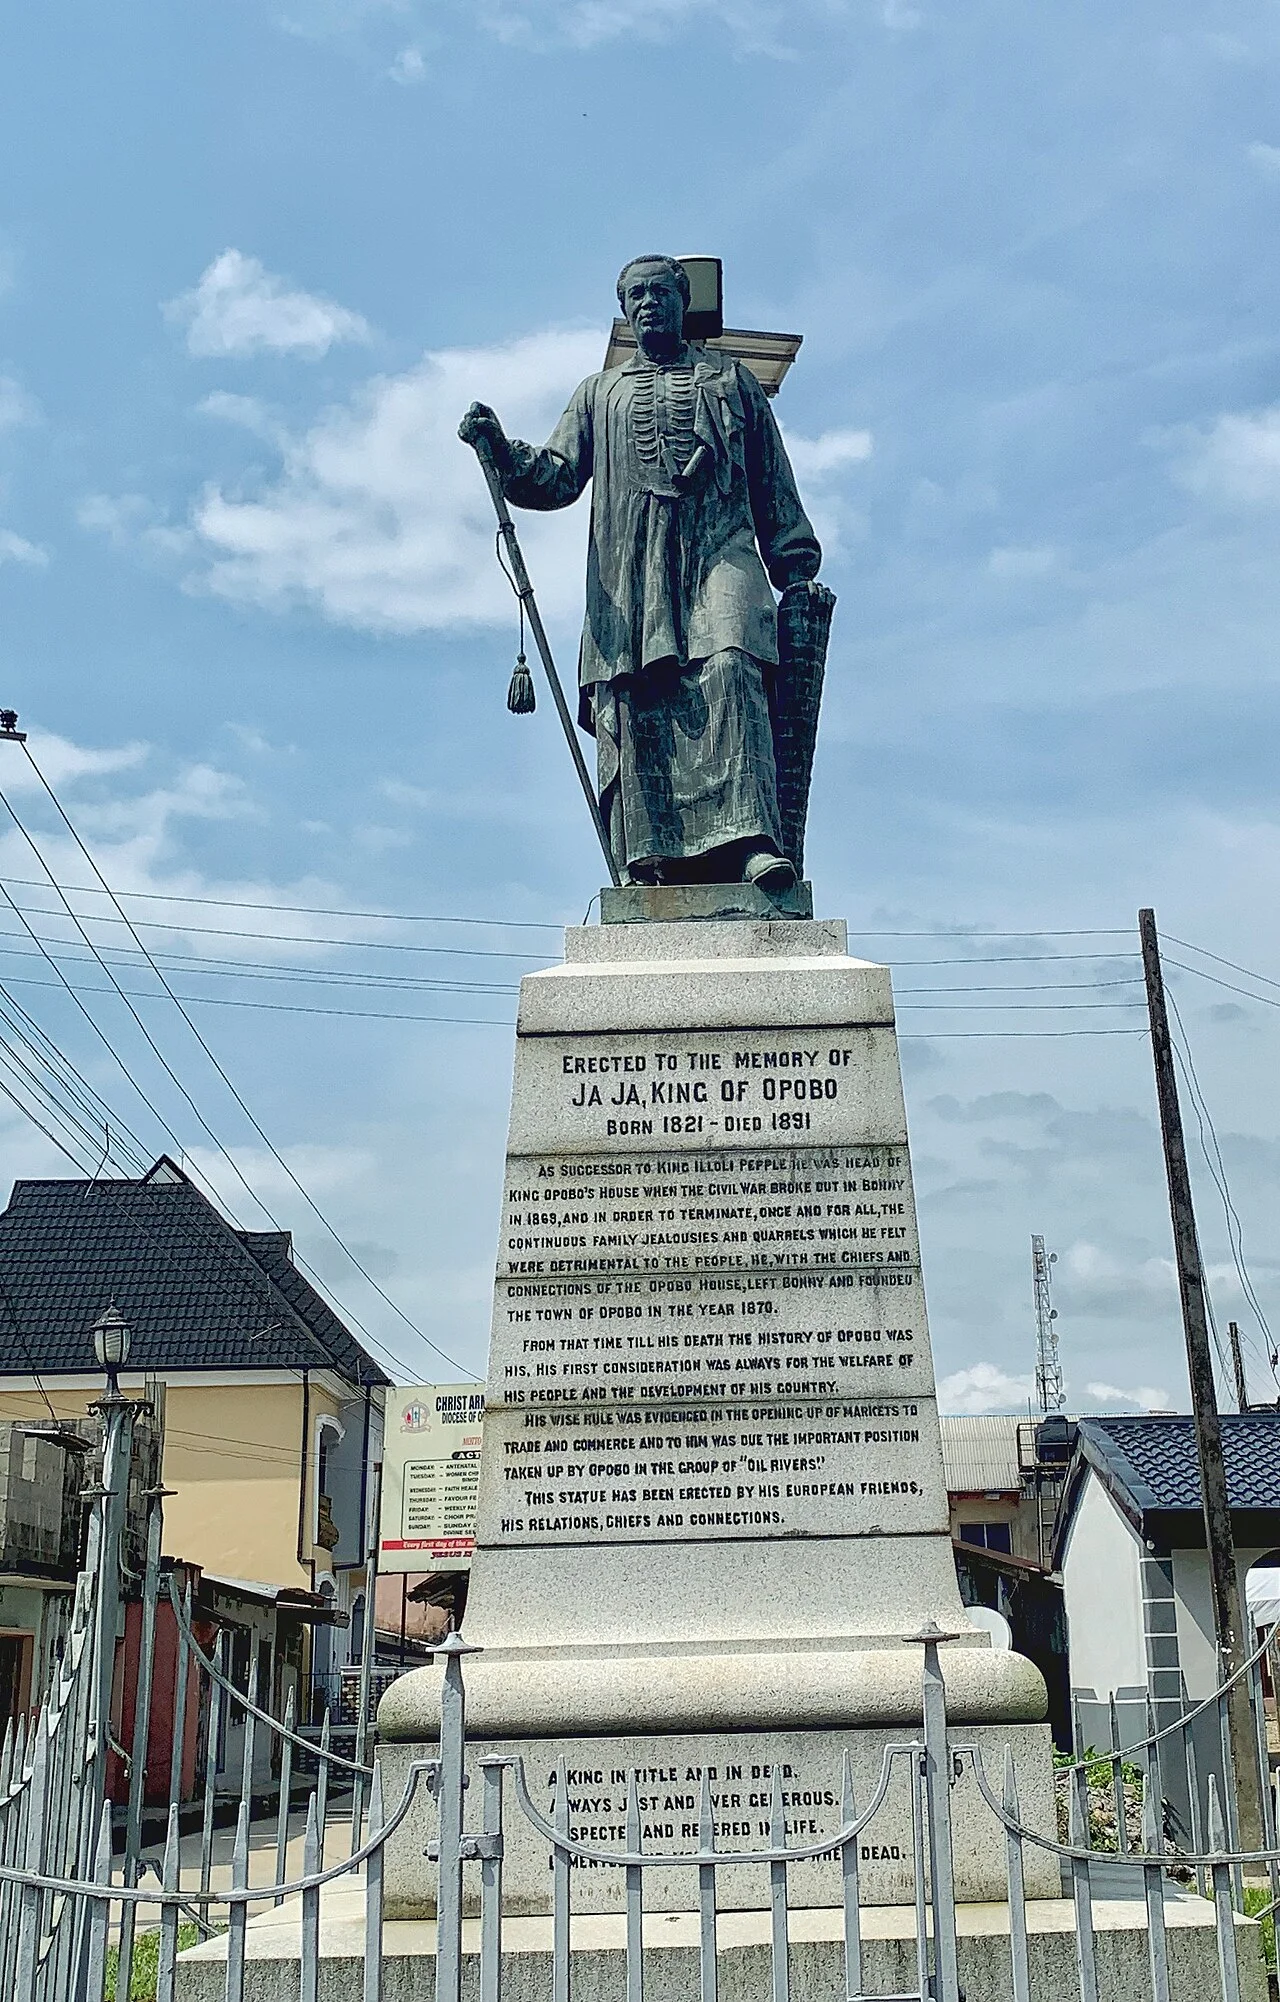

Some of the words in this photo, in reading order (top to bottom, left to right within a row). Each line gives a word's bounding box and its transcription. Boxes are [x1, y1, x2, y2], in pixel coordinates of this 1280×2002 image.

[563, 1056, 646, 1073] ERECTED
[655, 1053, 677, 1071] TO
[688, 1053, 721, 1069] THE
[735, 1051, 819, 1068] MEMORY
[829, 1050, 852, 1066] OF
[572, 1083, 602, 1106] JA
[650, 1082, 708, 1103] KING
[721, 1080, 749, 1101] OF
[763, 1078, 837, 1100] OPOBO
[607, 1119, 653, 1136] BORN
[663, 1116, 703, 1133] 1821
[725, 1116, 761, 1131] DIED
[772, 1112, 810, 1130] 1891
[538, 1165, 554, 1177] AS
[561, 1164, 632, 1176] SUCCESSOR
[657, 1162, 689, 1174] KING
[740, 1158, 786, 1171] PEPPLE
[509, 1189, 539, 1202] KING
[544, 1187, 594, 1201] OPOBO'S
[600, 1186, 639, 1199] HOUSE
[643, 1186, 677, 1198] WHEN
[681, 1184, 704, 1197] THE
[708, 1183, 738, 1195] CIVIL
[740, 1182, 766, 1194] WAR
[770, 1182, 811, 1194] BROKE
[816, 1181, 839, 1192] OUT
[509, 1214, 521, 1226] IN
[613, 1211, 653, 1222] ORDER
[658, 1210, 675, 1221] TO
[796, 1205, 821, 1217] AND
[827, 1205, 850, 1216] FOR
[508, 1237, 586, 1250] CONTINUOUS
[593, 1234, 638, 1247] FAMILY
[641, 1232, 718, 1245] JEALOUSIES
[723, 1231, 747, 1242] AND
[753, 1229, 815, 1242] QUARRELS
[819, 1227, 857, 1240] WHICH
[881, 1227, 906, 1238] FELT
[508, 1261, 544, 1273] WERE
[550, 1258, 639, 1272] DETRIMENTAL
[664, 1257, 689, 1268] THE
[813, 1252, 836, 1264] THE
[842, 1251, 883, 1263] CHIEFS
[507, 1283, 591, 1297] CONNECTIONS
[616, 1282, 641, 1293] THE
[650, 1280, 692, 1292] OPOBO
[507, 1310, 531, 1322] THE
[536, 1309, 572, 1321] TOWN
[600, 1306, 642, 1319] OPOBO
[668, 1304, 692, 1316] THE
[699, 1303, 734, 1316] YEAR
[741, 1301, 778, 1315] 1870.
[523, 1340, 555, 1352] FROM
[560, 1338, 589, 1350] THAT
[593, 1337, 622, 1349] TIME
[627, 1336, 654, 1348] TILL
[658, 1335, 678, 1347] HIS
[684, 1334, 723, 1347] DEATH
[729, 1334, 752, 1345] THE
[758, 1332, 813, 1345] HISTORY
[838, 1330, 881, 1342] OPOBO
[536, 1363, 557, 1376] HIS
[563, 1363, 598, 1375] FIRST
[603, 1359, 700, 1374] CONSIDERATION
[706, 1359, 731, 1370] WAS
[735, 1357, 781, 1370] ALWAYS
[786, 1357, 808, 1369] FOR
[812, 1356, 835, 1368] THE
[839, 1355, 893, 1367] WELFARE
[504, 1390, 525, 1402] HIS
[530, 1388, 577, 1401] PEOPLE
[582, 1388, 606, 1400] AND
[611, 1387, 634, 1399] THE
[641, 1384, 726, 1397] DEVELOPMENT
[731, 1383, 745, 1395] OF
[777, 1381, 839, 1394] COUNTRY.
[436, 1396, 467, 1411] CHRIST
[726, 1409, 749, 1421] THE
[843, 1405, 899, 1418] MARKETS
[442, 1411, 467, 1424] DIOCESE
[469, 1411, 476, 1423] OF
[504, 1441, 540, 1454] TRADE
[544, 1440, 567, 1452] AND
[573, 1438, 635, 1451] COMMERCE
[712, 1435, 736, 1447] WAS
[741, 1434, 762, 1446] DUE
[767, 1434, 789, 1445] THE
[793, 1432, 860, 1444] IMPORTANT
[865, 1430, 919, 1443] POSITION
[504, 1466, 542, 1480] TAKEN
[567, 1465, 585, 1477] BY
[589, 1463, 629, 1476] OPOBO
[651, 1462, 675, 1475] THE
[679, 1461, 719, 1473] GROUP
[723, 1461, 737, 1472] OF
[525, 1491, 554, 1505] THIS
[559, 1490, 606, 1504] STATUE
[612, 1490, 637, 1502] HAS
[643, 1488, 673, 1500] BEEN
[680, 1487, 731, 1499] ERECTED
[737, 1486, 754, 1499] BY
[759, 1485, 780, 1498] HIS
[786, 1483, 854, 1497] EUROPEAN
[501, 1519, 523, 1532] HIS
[529, 1517, 604, 1532] RELATIONS,
[606, 1515, 650, 1529] CHIEFS
[657, 1515, 683, 1527] AND
[690, 1511, 785, 1526] CONNECTIONS.
[568, 1770, 603, 1785] KING
[611, 1770, 626, 1784] IN
[635, 1768, 677, 1783] TITLE
[726, 1766, 742, 1780] IN
[752, 1765, 800, 1779] DED.
[549, 1799, 611, 1813] WAYS
[618, 1797, 659, 1812] JST
[664, 1796, 695, 1810] AND
[708, 1794, 741, 1808] VER
[749, 1791, 839, 1807] GEEROUS.
[643, 1824, 673, 1839] AND
[682, 1821, 750, 1838] REERED
[784, 1820, 825, 1834] LIFE.
[861, 1846, 906, 1860] DEAD.
